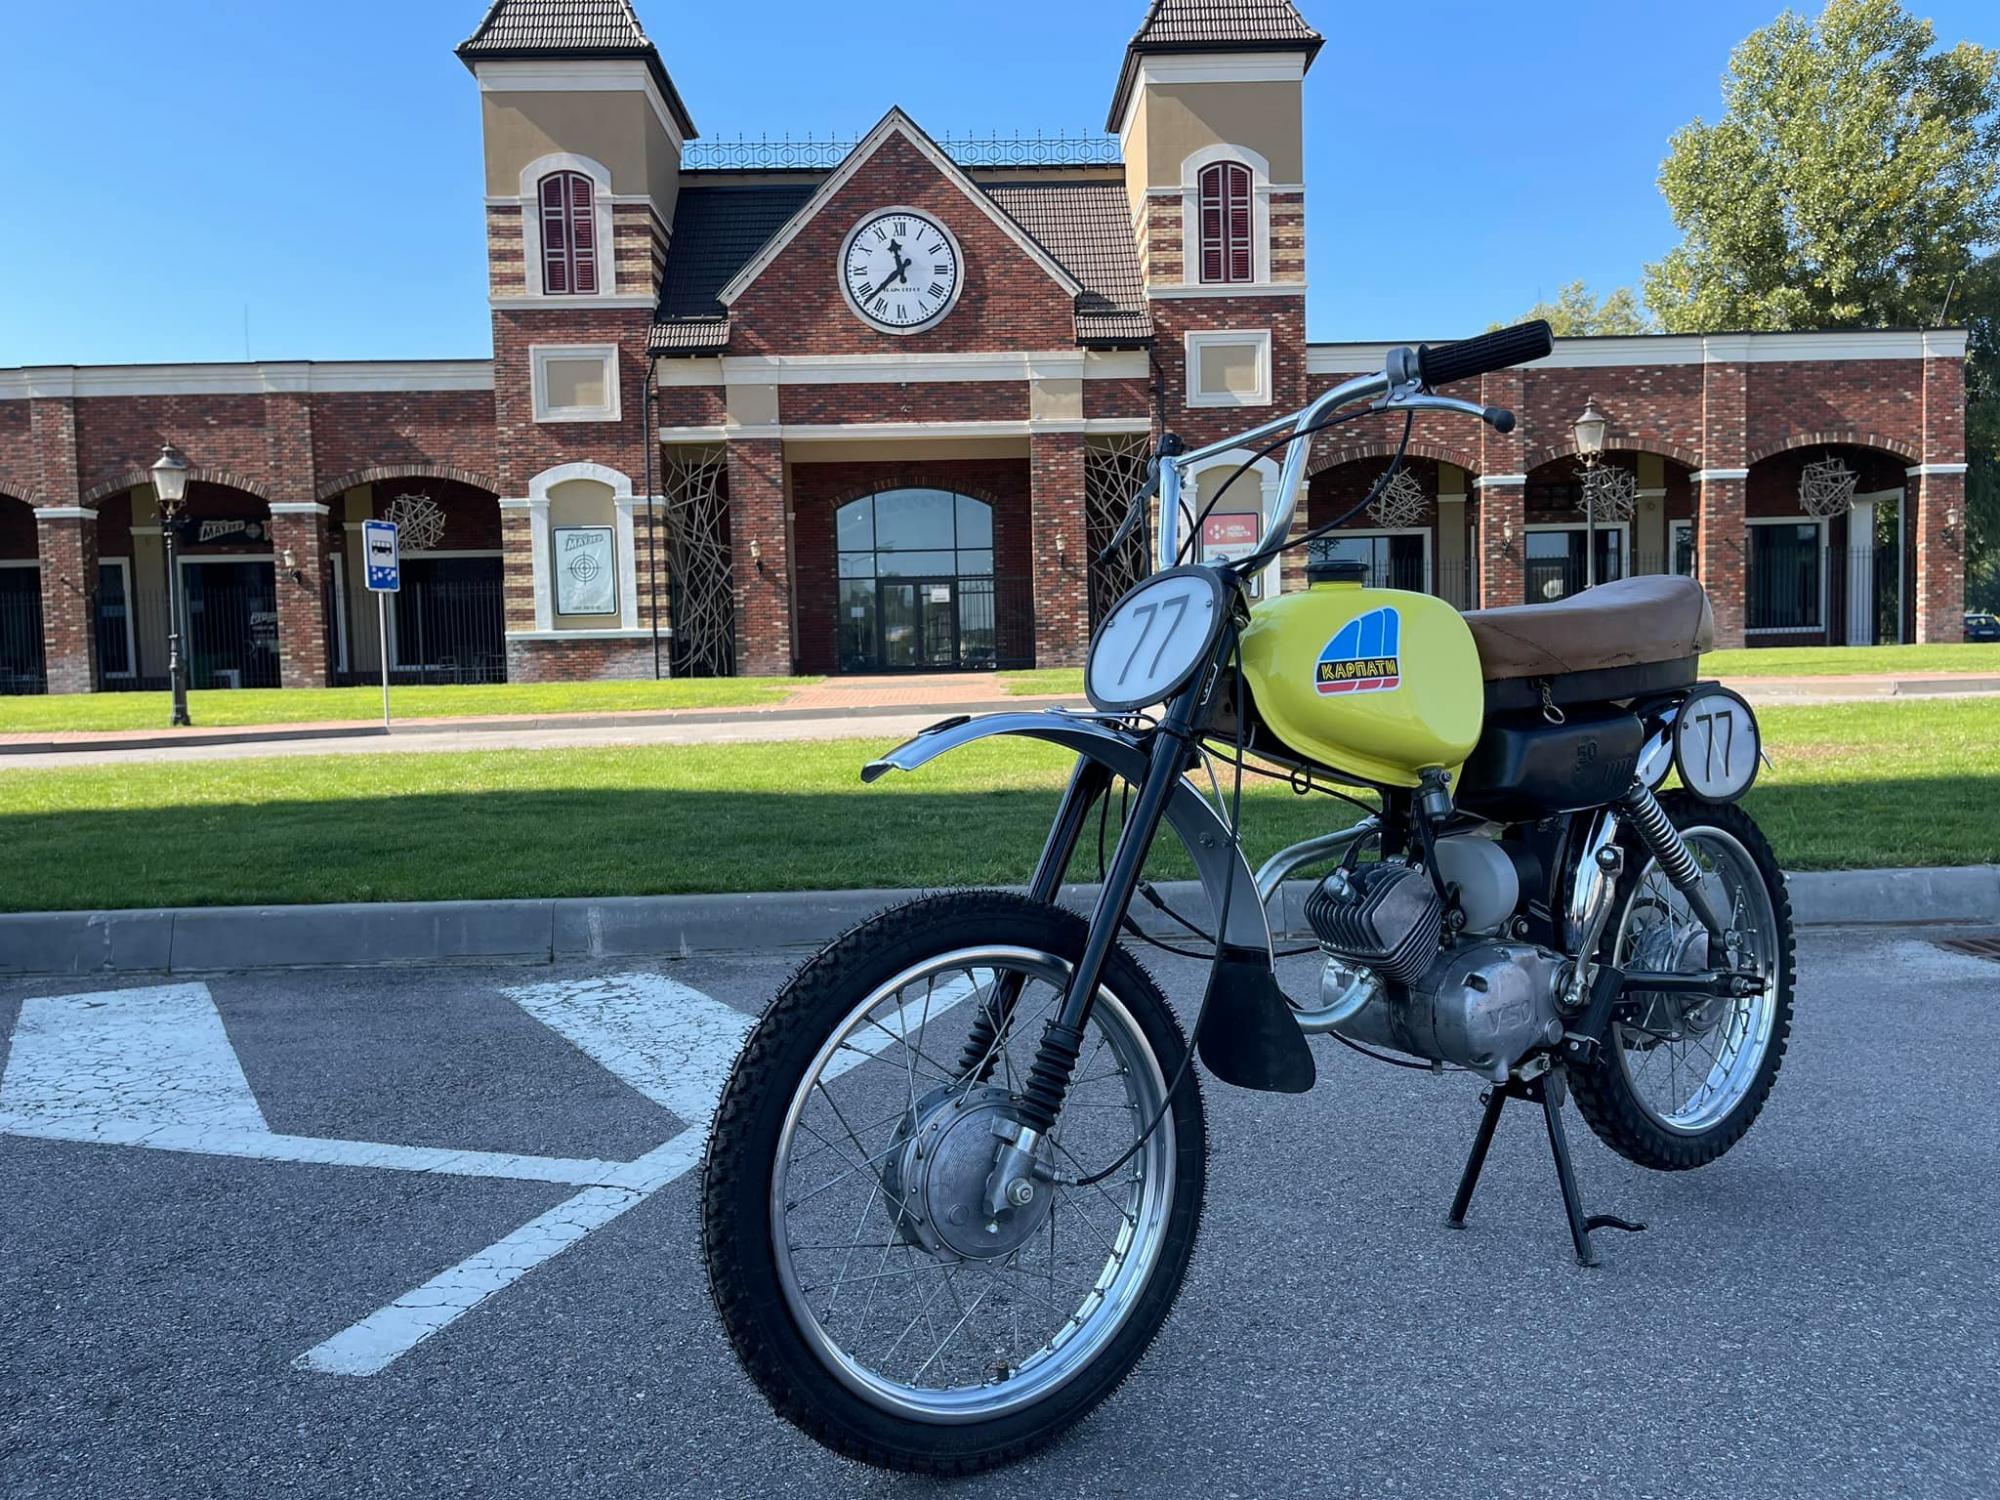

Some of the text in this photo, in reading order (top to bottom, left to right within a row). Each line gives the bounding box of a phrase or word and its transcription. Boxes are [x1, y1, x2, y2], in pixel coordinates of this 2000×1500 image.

[1117, 593, 1191, 686] 77
[1321, 660, 1396, 680] КАРПАТИ
[1695, 710, 1733, 783] 77
